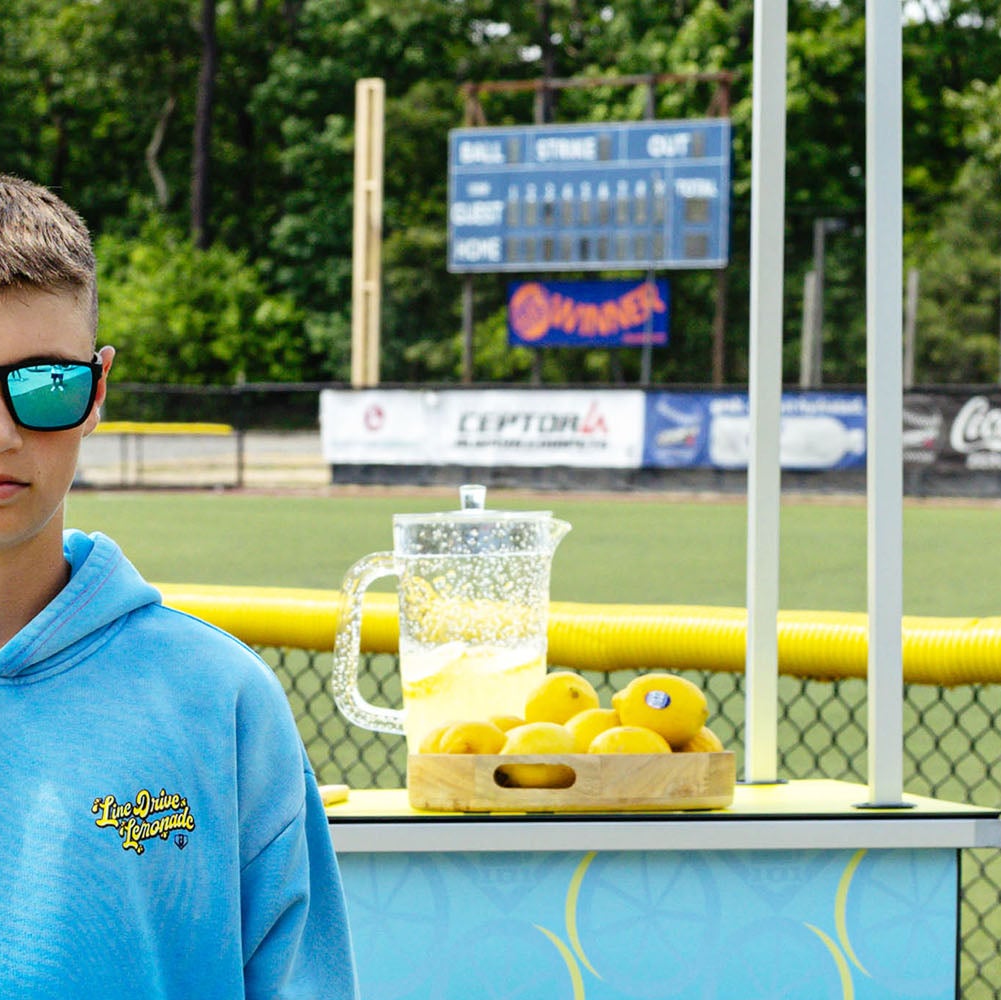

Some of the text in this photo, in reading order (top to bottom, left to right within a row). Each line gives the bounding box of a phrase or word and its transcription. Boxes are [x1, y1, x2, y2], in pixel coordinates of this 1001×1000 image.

[94, 788, 181, 829] Line Drive
[121, 806, 195, 852] Lemonade
